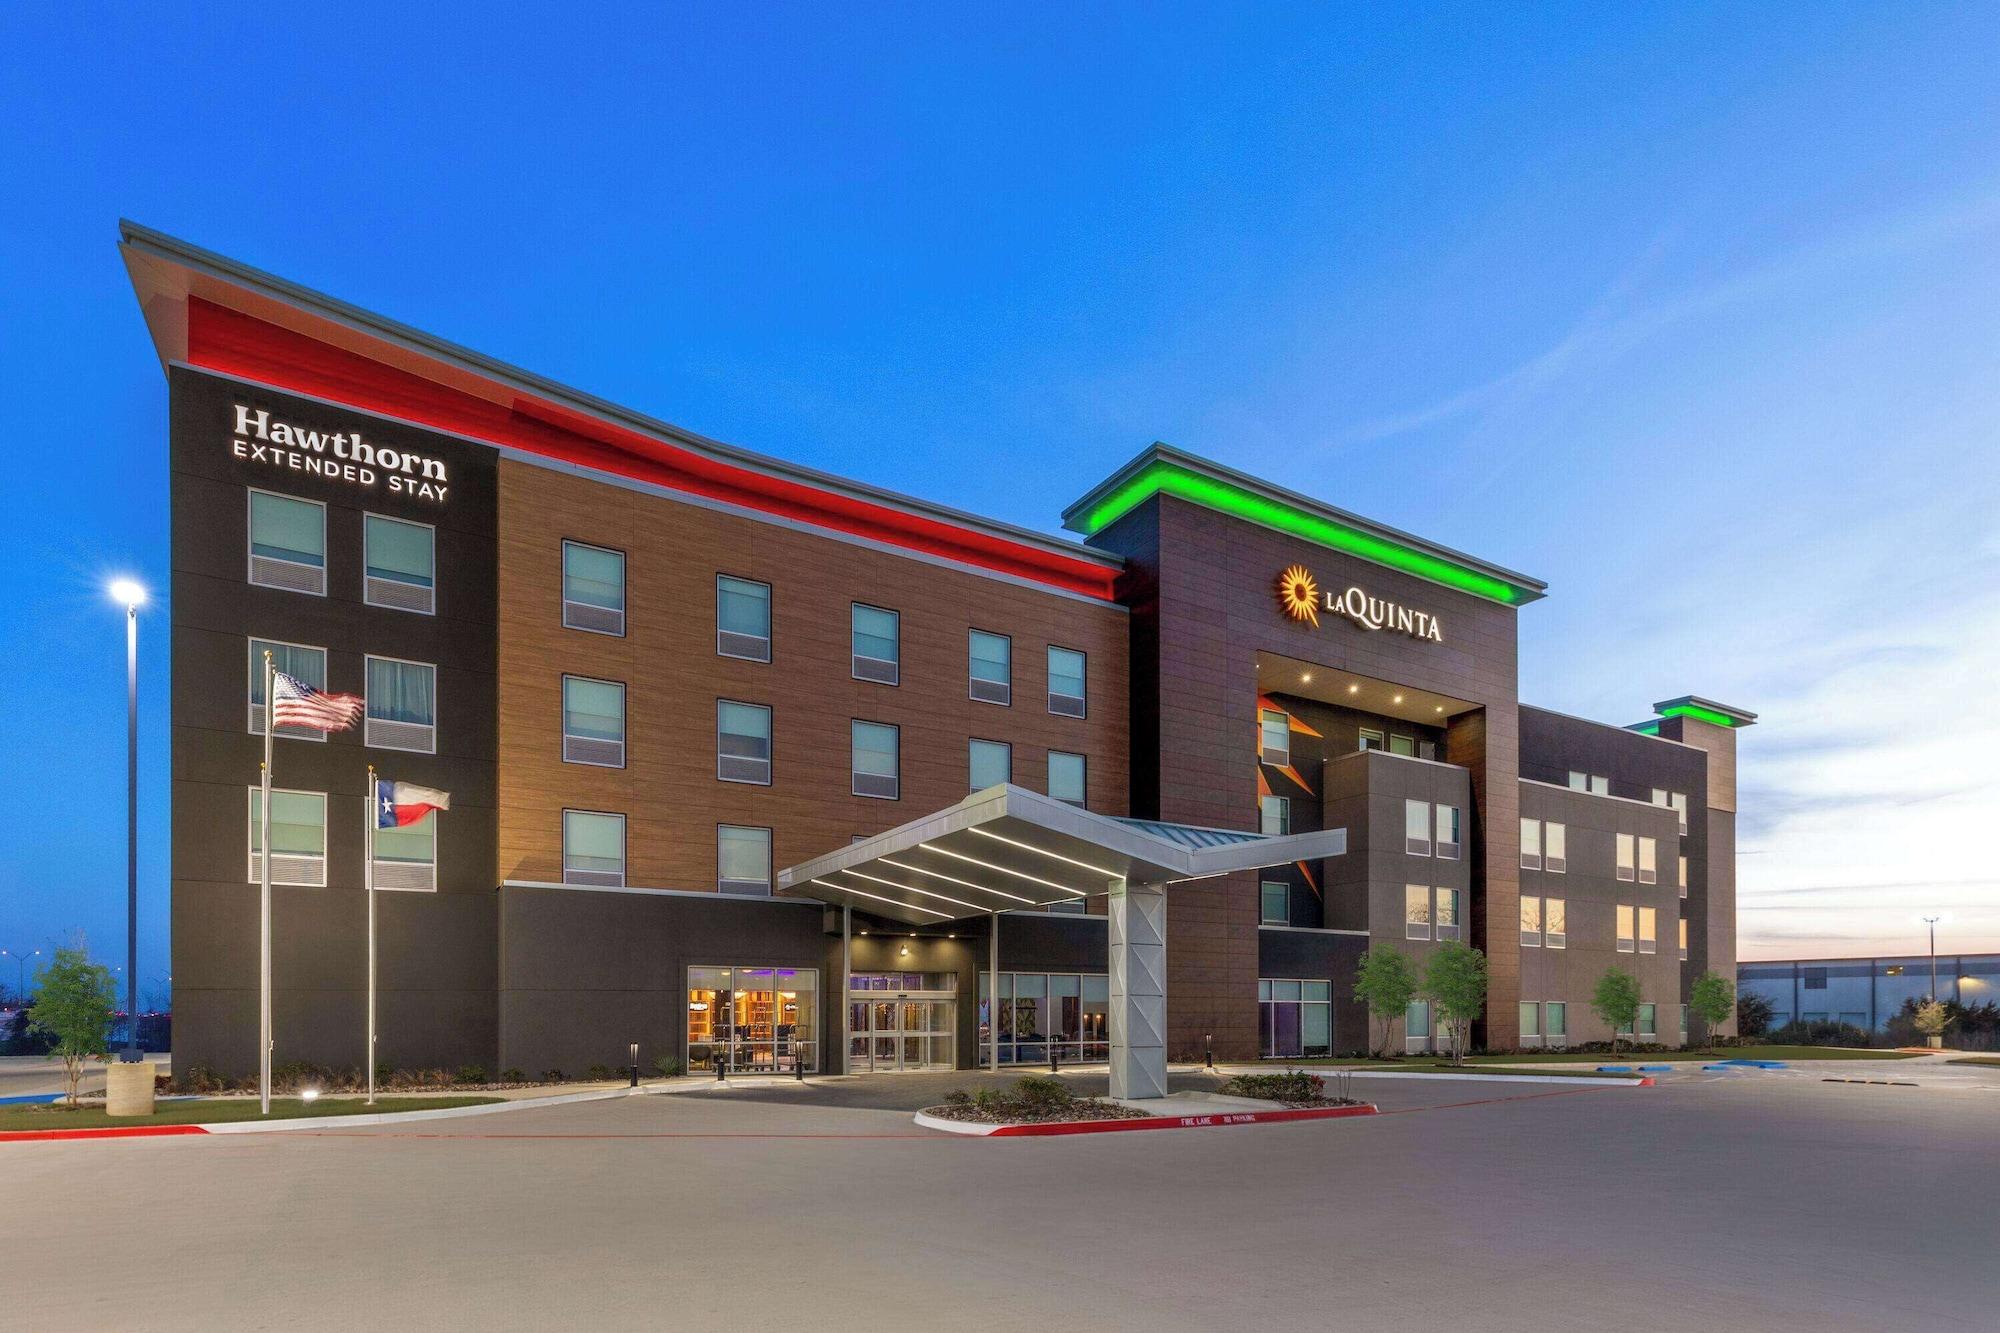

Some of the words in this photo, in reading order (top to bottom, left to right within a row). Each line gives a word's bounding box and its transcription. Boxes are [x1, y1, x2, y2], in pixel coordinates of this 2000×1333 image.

[233, 440, 375, 485] EXTENDED
[389, 475, 447, 501] STAY
[234, 405, 448, 481] Hawthorn
[1196, 1117, 1212, 1125] LANE
[1232, 1114, 1256, 1122] PARKING
